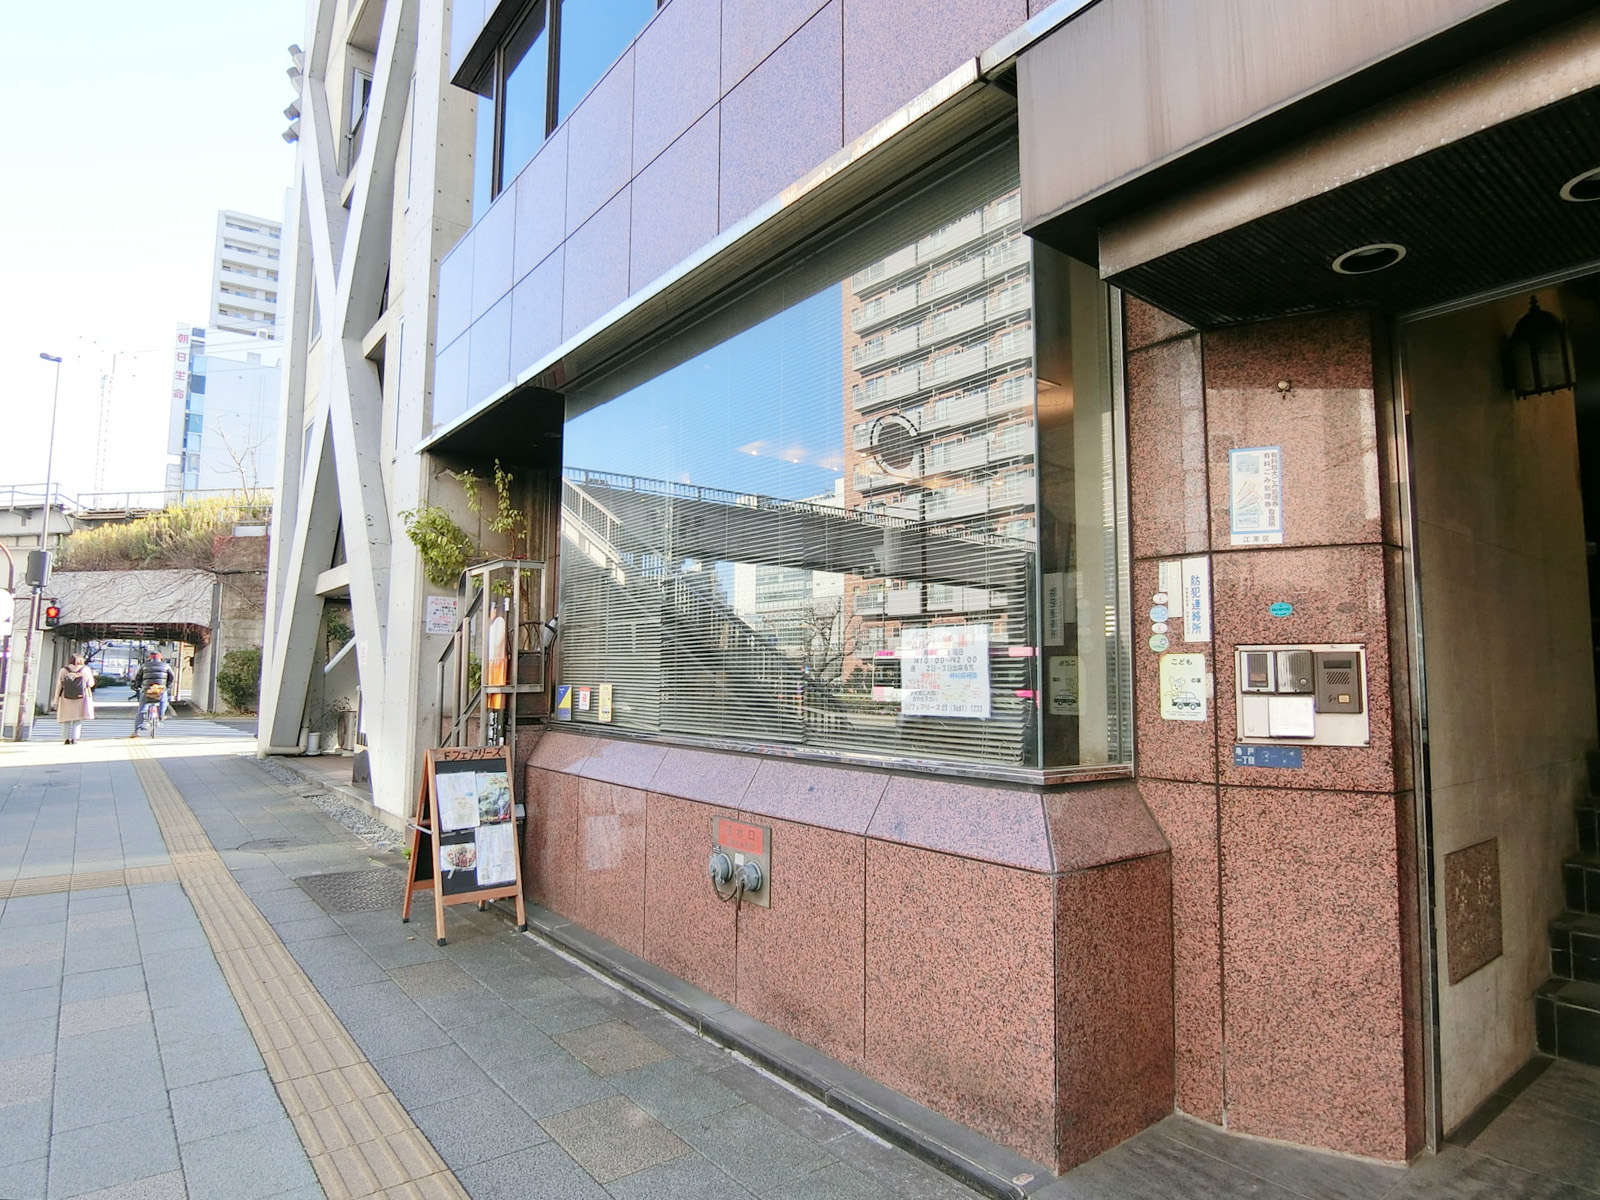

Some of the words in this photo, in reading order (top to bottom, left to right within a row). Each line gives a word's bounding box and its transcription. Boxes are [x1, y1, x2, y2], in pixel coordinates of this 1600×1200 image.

[174, 333, 189, 399] 朝日生命
[1263, 452, 1271, 508] 有料ごみ処理券
[1190, 575, 1202, 634] 防犯連絡所
[1171, 658, 1193, 666] こども
